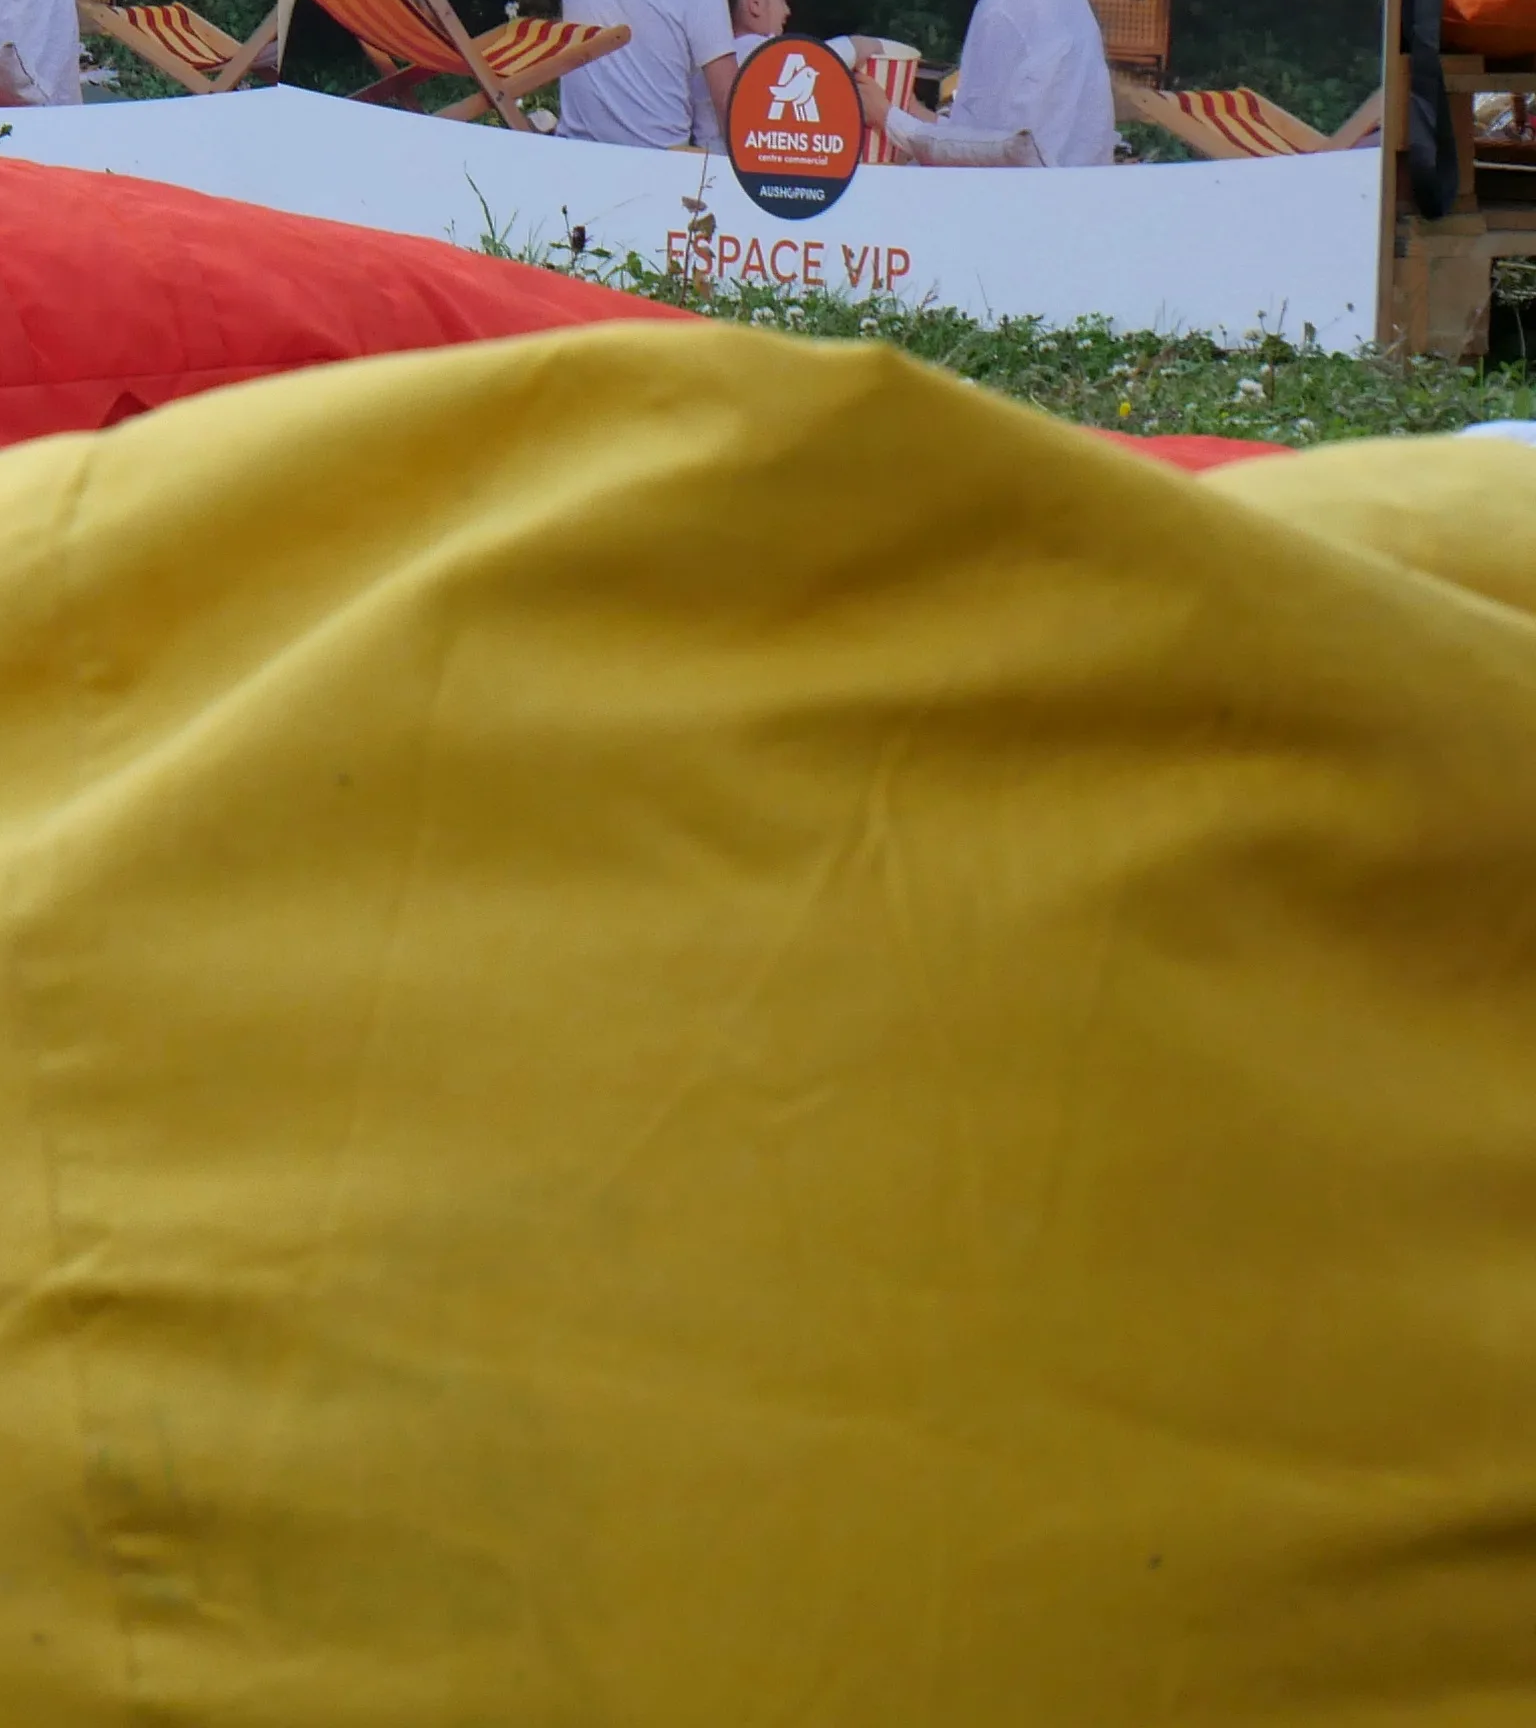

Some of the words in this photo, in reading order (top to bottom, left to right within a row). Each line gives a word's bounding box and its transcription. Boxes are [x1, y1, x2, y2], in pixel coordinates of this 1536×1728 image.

[744, 130, 808, 152] AMIENS
[812, 133, 844, 154] SUD
[758, 154, 783, 163] centre
[784, 155, 828, 166] commercial
[666, 230, 826, 286] ESPACE
[840, 243, 911, 291] VIP
